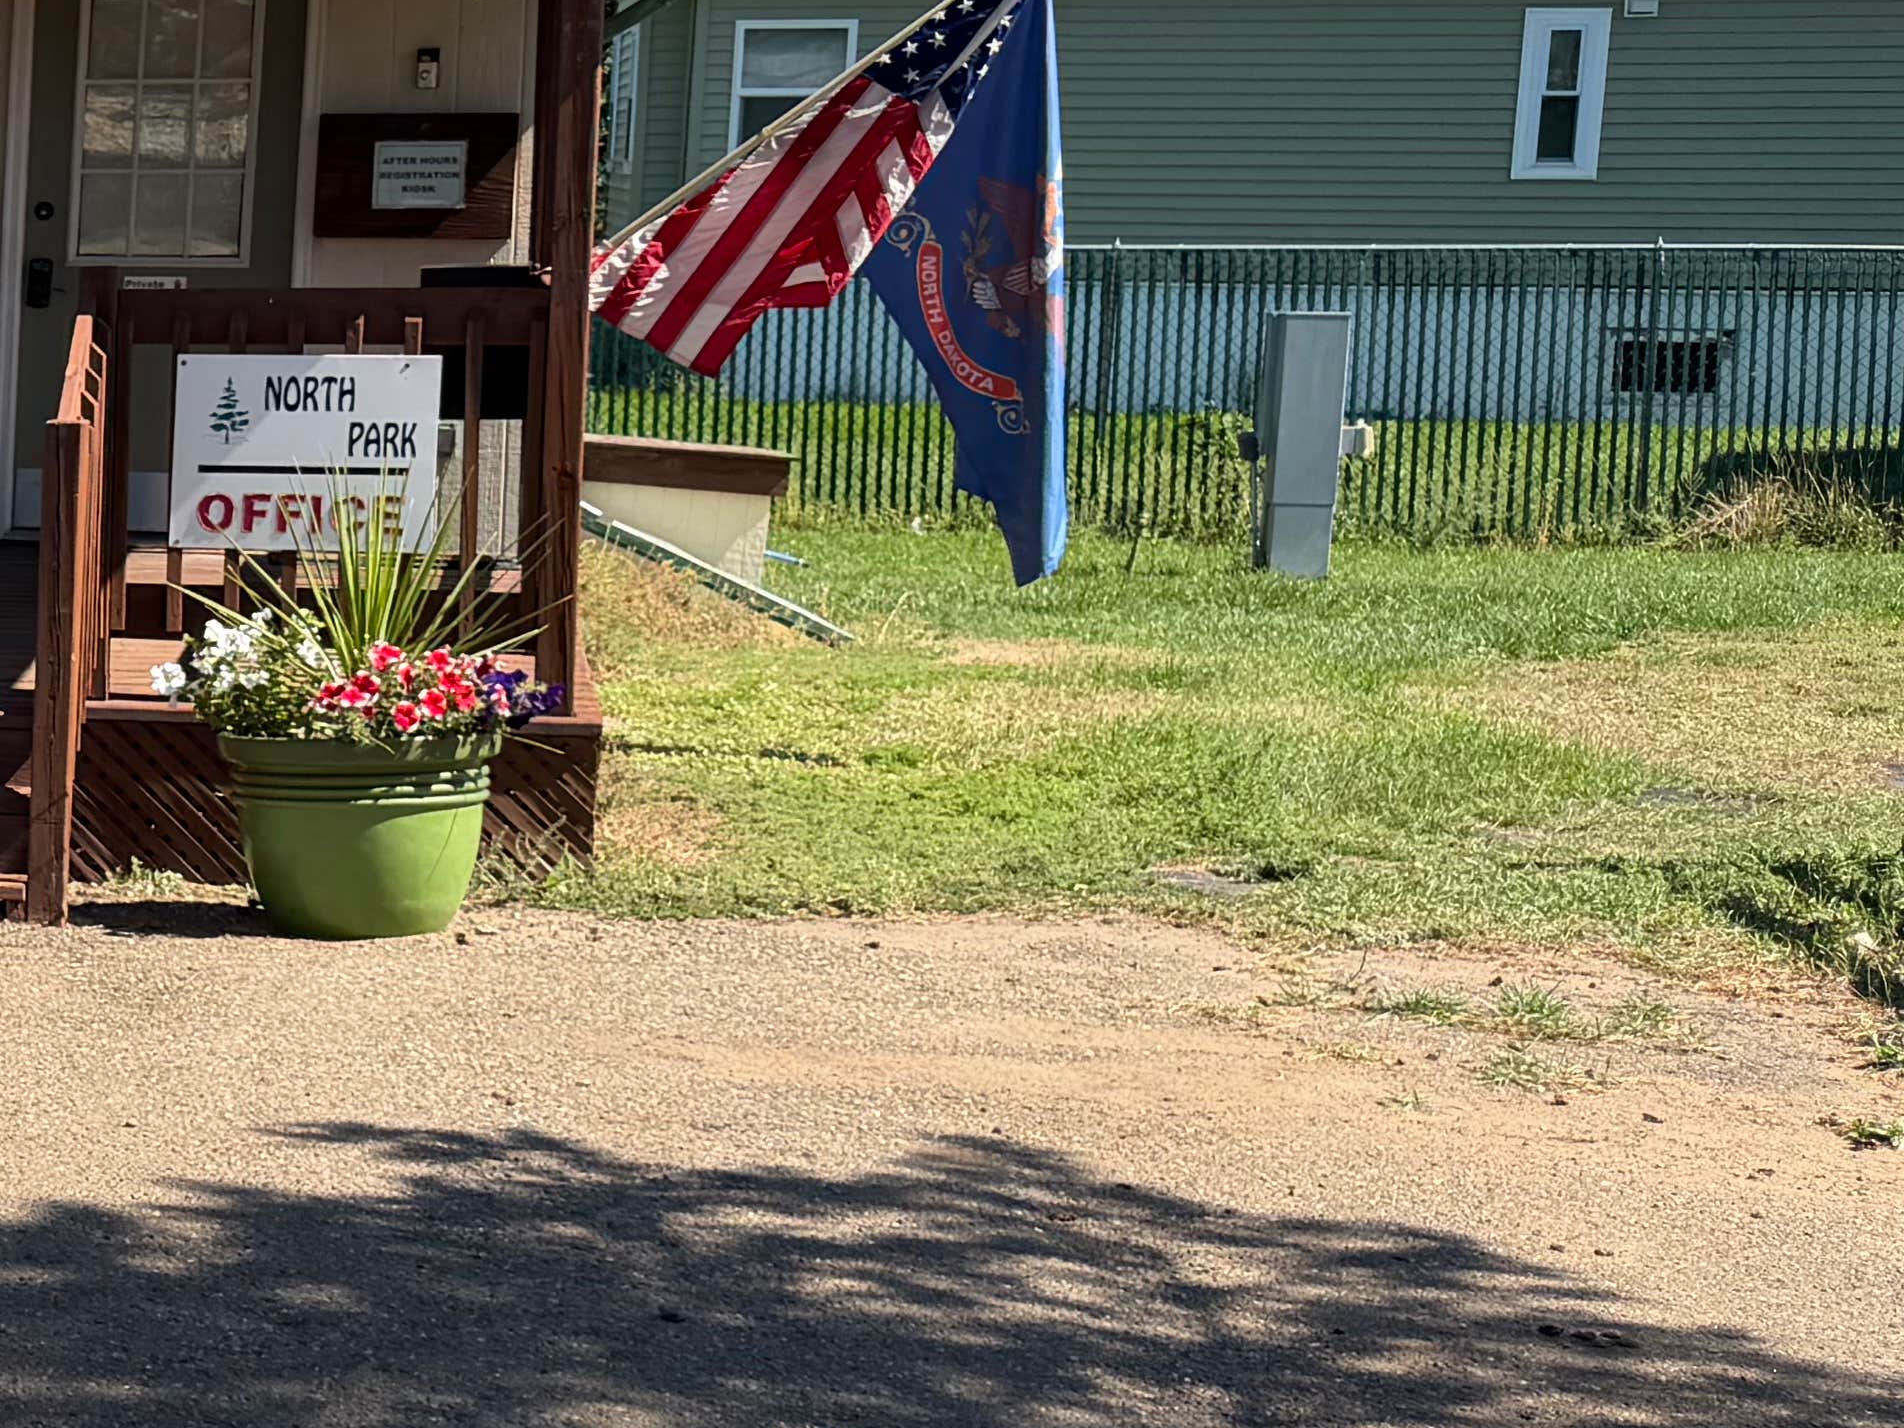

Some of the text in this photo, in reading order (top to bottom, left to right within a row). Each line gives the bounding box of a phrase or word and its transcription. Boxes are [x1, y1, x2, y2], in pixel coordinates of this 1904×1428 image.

[378, 171, 460, 180] REGISTRATION
[382, 155, 459, 165] AFTER HOURS
[921, 254, 995, 392] NORTH DAKOTA
[263, 375, 356, 413] NORTH
[347, 421, 418, 458] PARK
